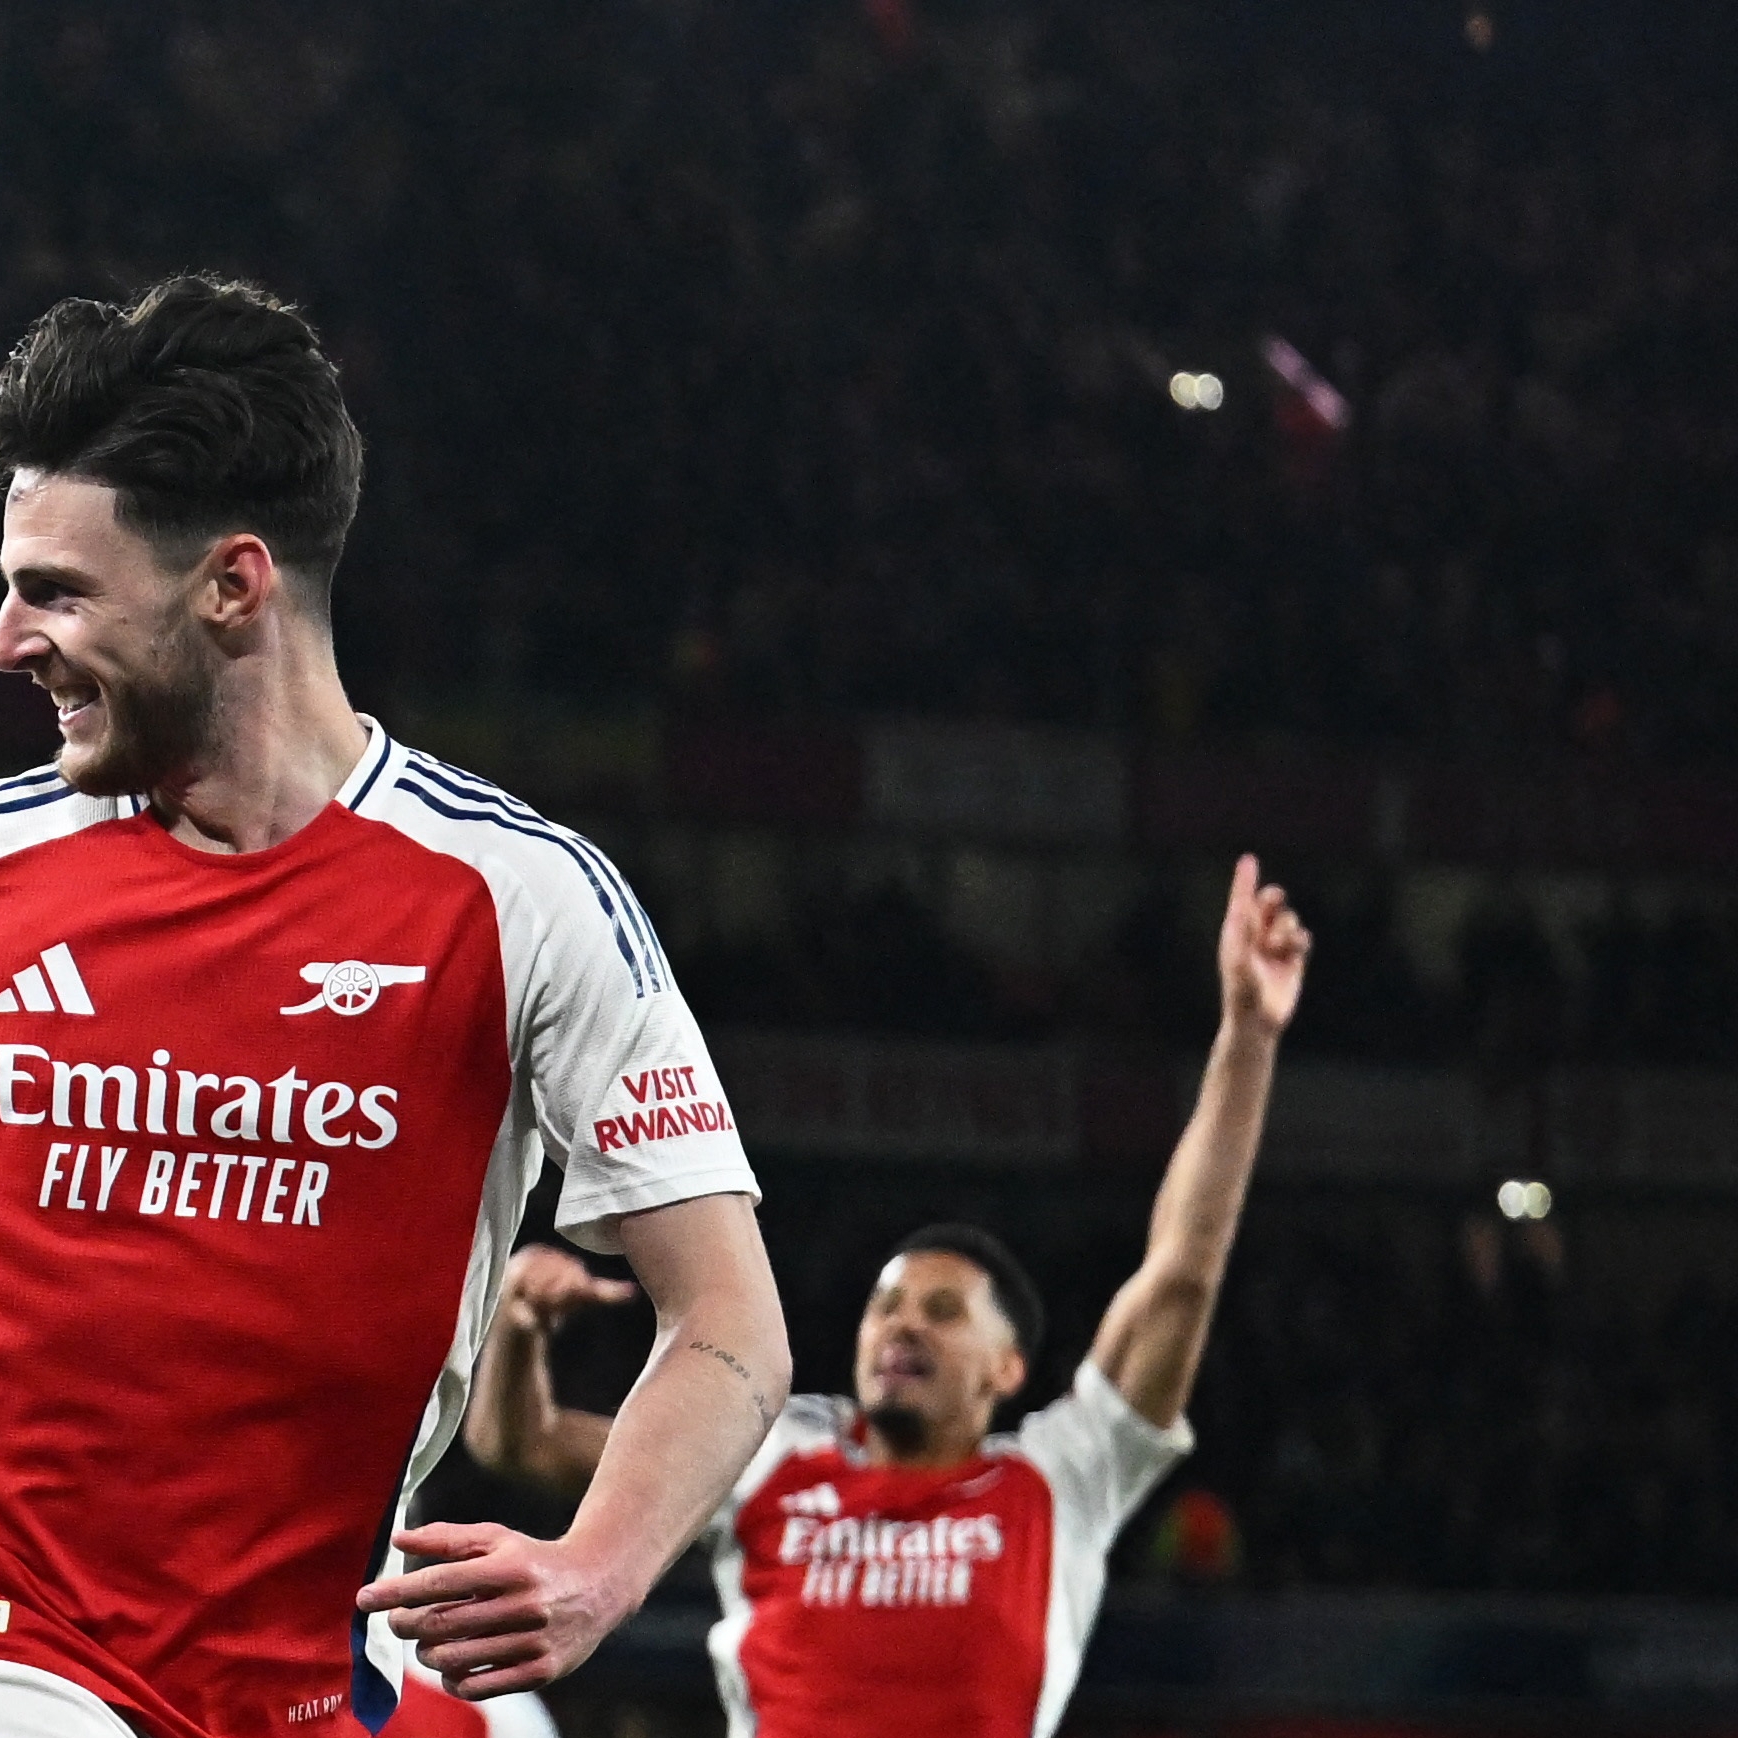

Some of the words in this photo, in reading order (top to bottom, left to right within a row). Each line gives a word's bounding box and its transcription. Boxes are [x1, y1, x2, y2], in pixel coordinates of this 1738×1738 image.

[621, 1065, 697, 1104] VISIT
[593, 1101, 733, 1153] RWANDA
[38, 1142, 128, 1212] FLY
[139, 1150, 329, 1226] BETTER
